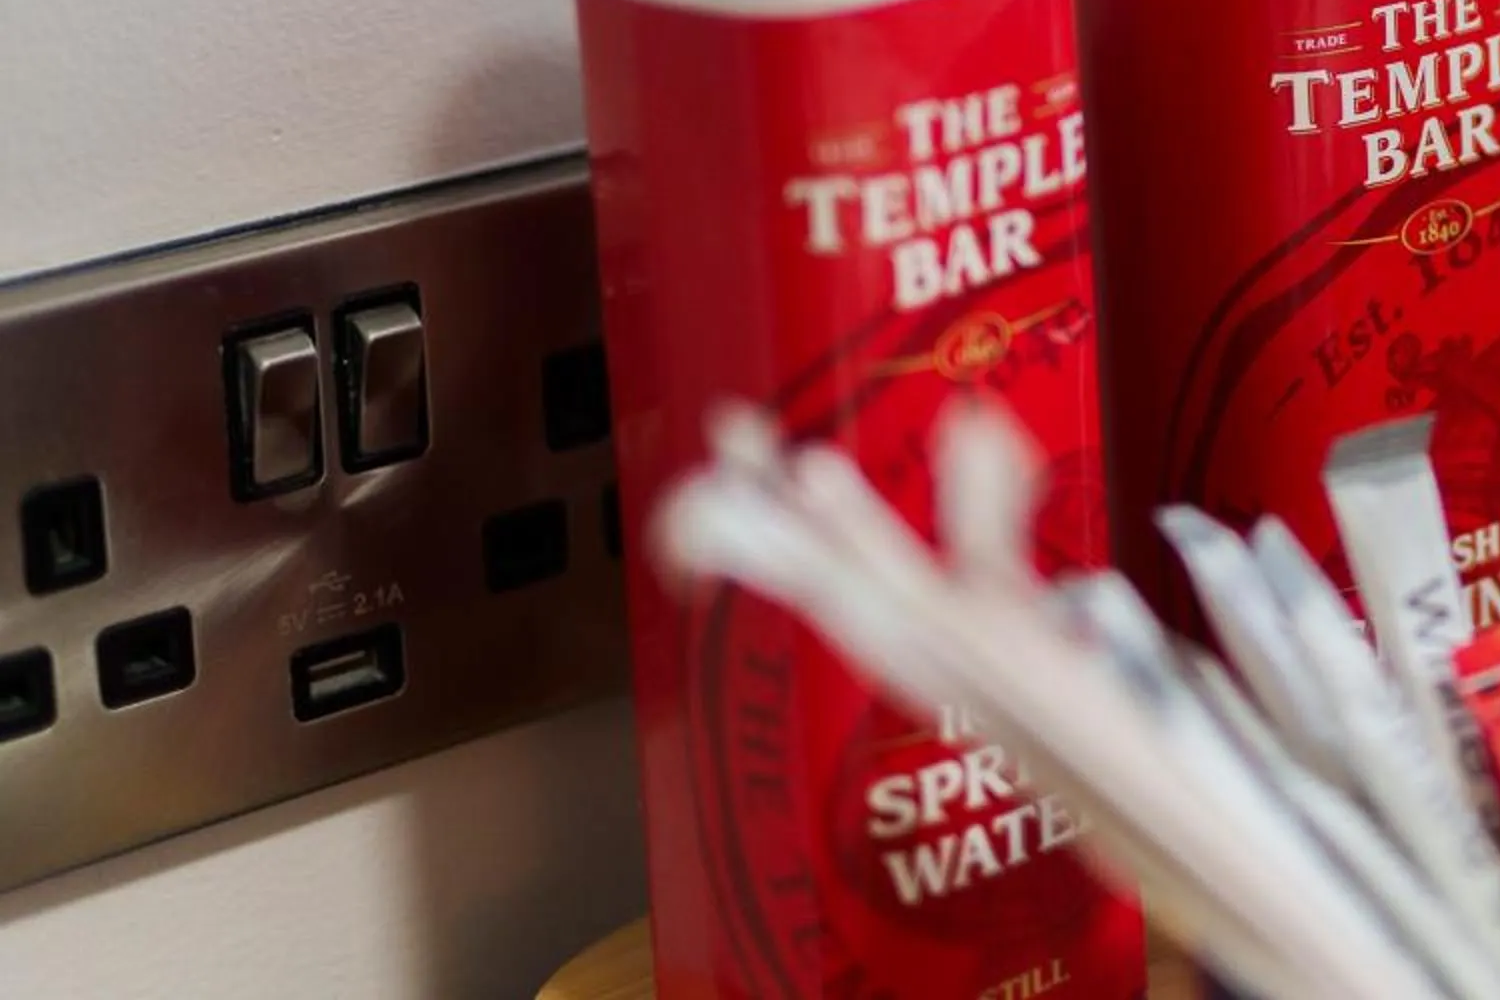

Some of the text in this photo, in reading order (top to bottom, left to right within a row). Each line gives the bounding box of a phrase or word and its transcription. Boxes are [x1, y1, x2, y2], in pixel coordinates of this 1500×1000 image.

[1295, 33, 1349, 52] TRADE
[896, 84, 1021, 160] THE
[784, 112, 1087, 256] TEMPLE
[890, 208, 1042, 310] BAR
[353, 581, 405, 616] 2.1A
[866, 744, 1032, 838] SPR
[882, 796, 1090, 906] WATE
